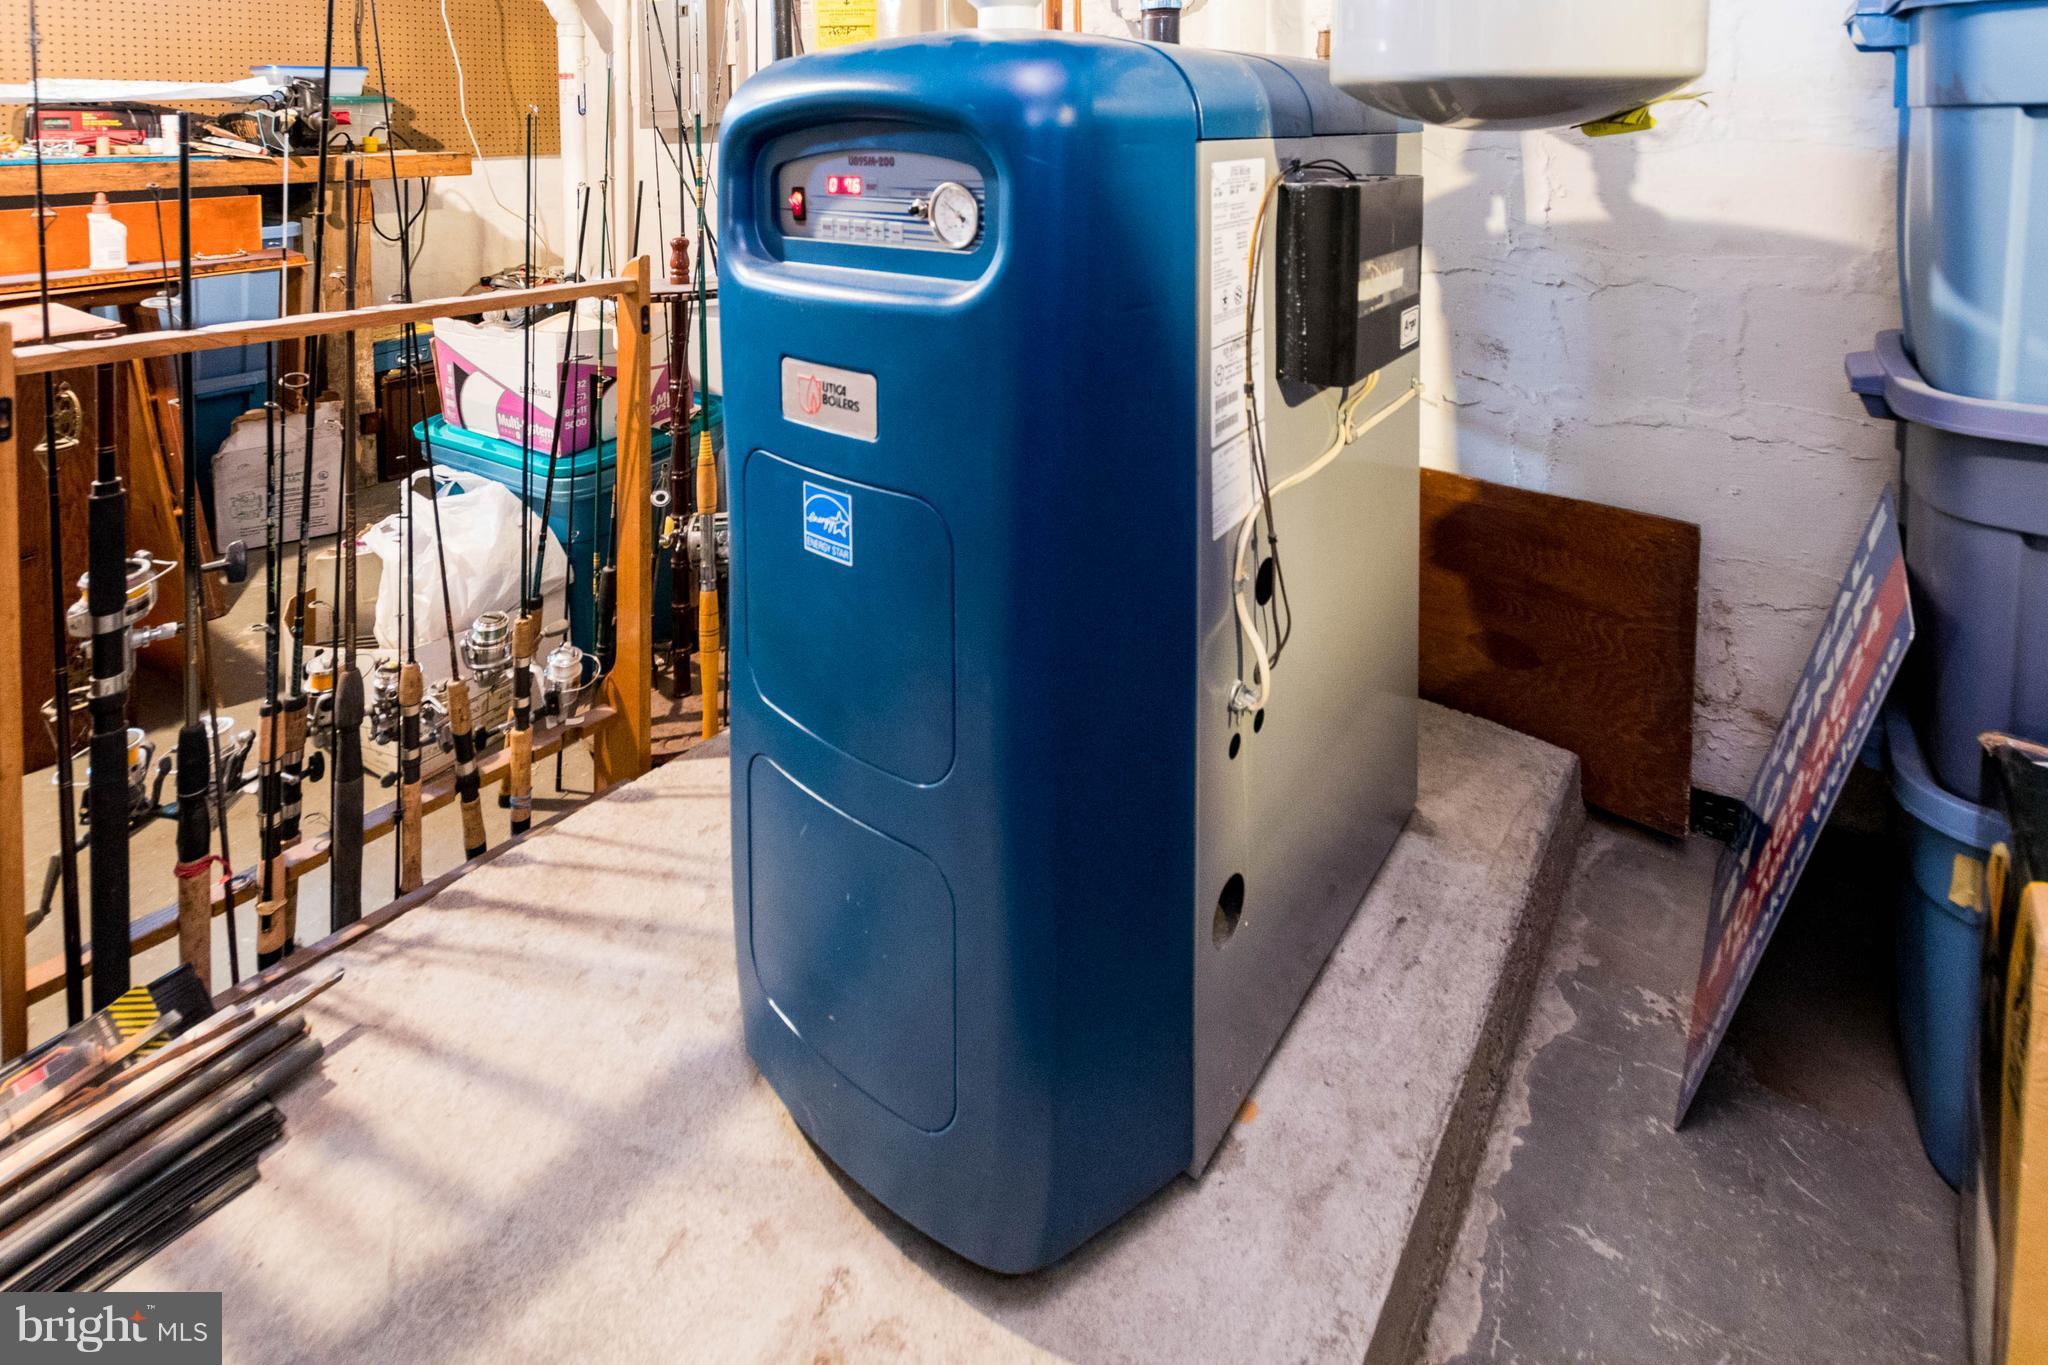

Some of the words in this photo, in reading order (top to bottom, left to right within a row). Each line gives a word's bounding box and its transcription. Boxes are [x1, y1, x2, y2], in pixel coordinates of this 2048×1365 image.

[821, 382, 847, 396] UTICA
[821, 393, 860, 413] BOILERS
[806, 534, 832, 553] ENERGY
[831, 543, 850, 561] STAR
[1814, 500, 1889, 676] SALE
[1762, 570, 1874, 832] OWNER
[1811, 631, 1900, 833] Welcome
